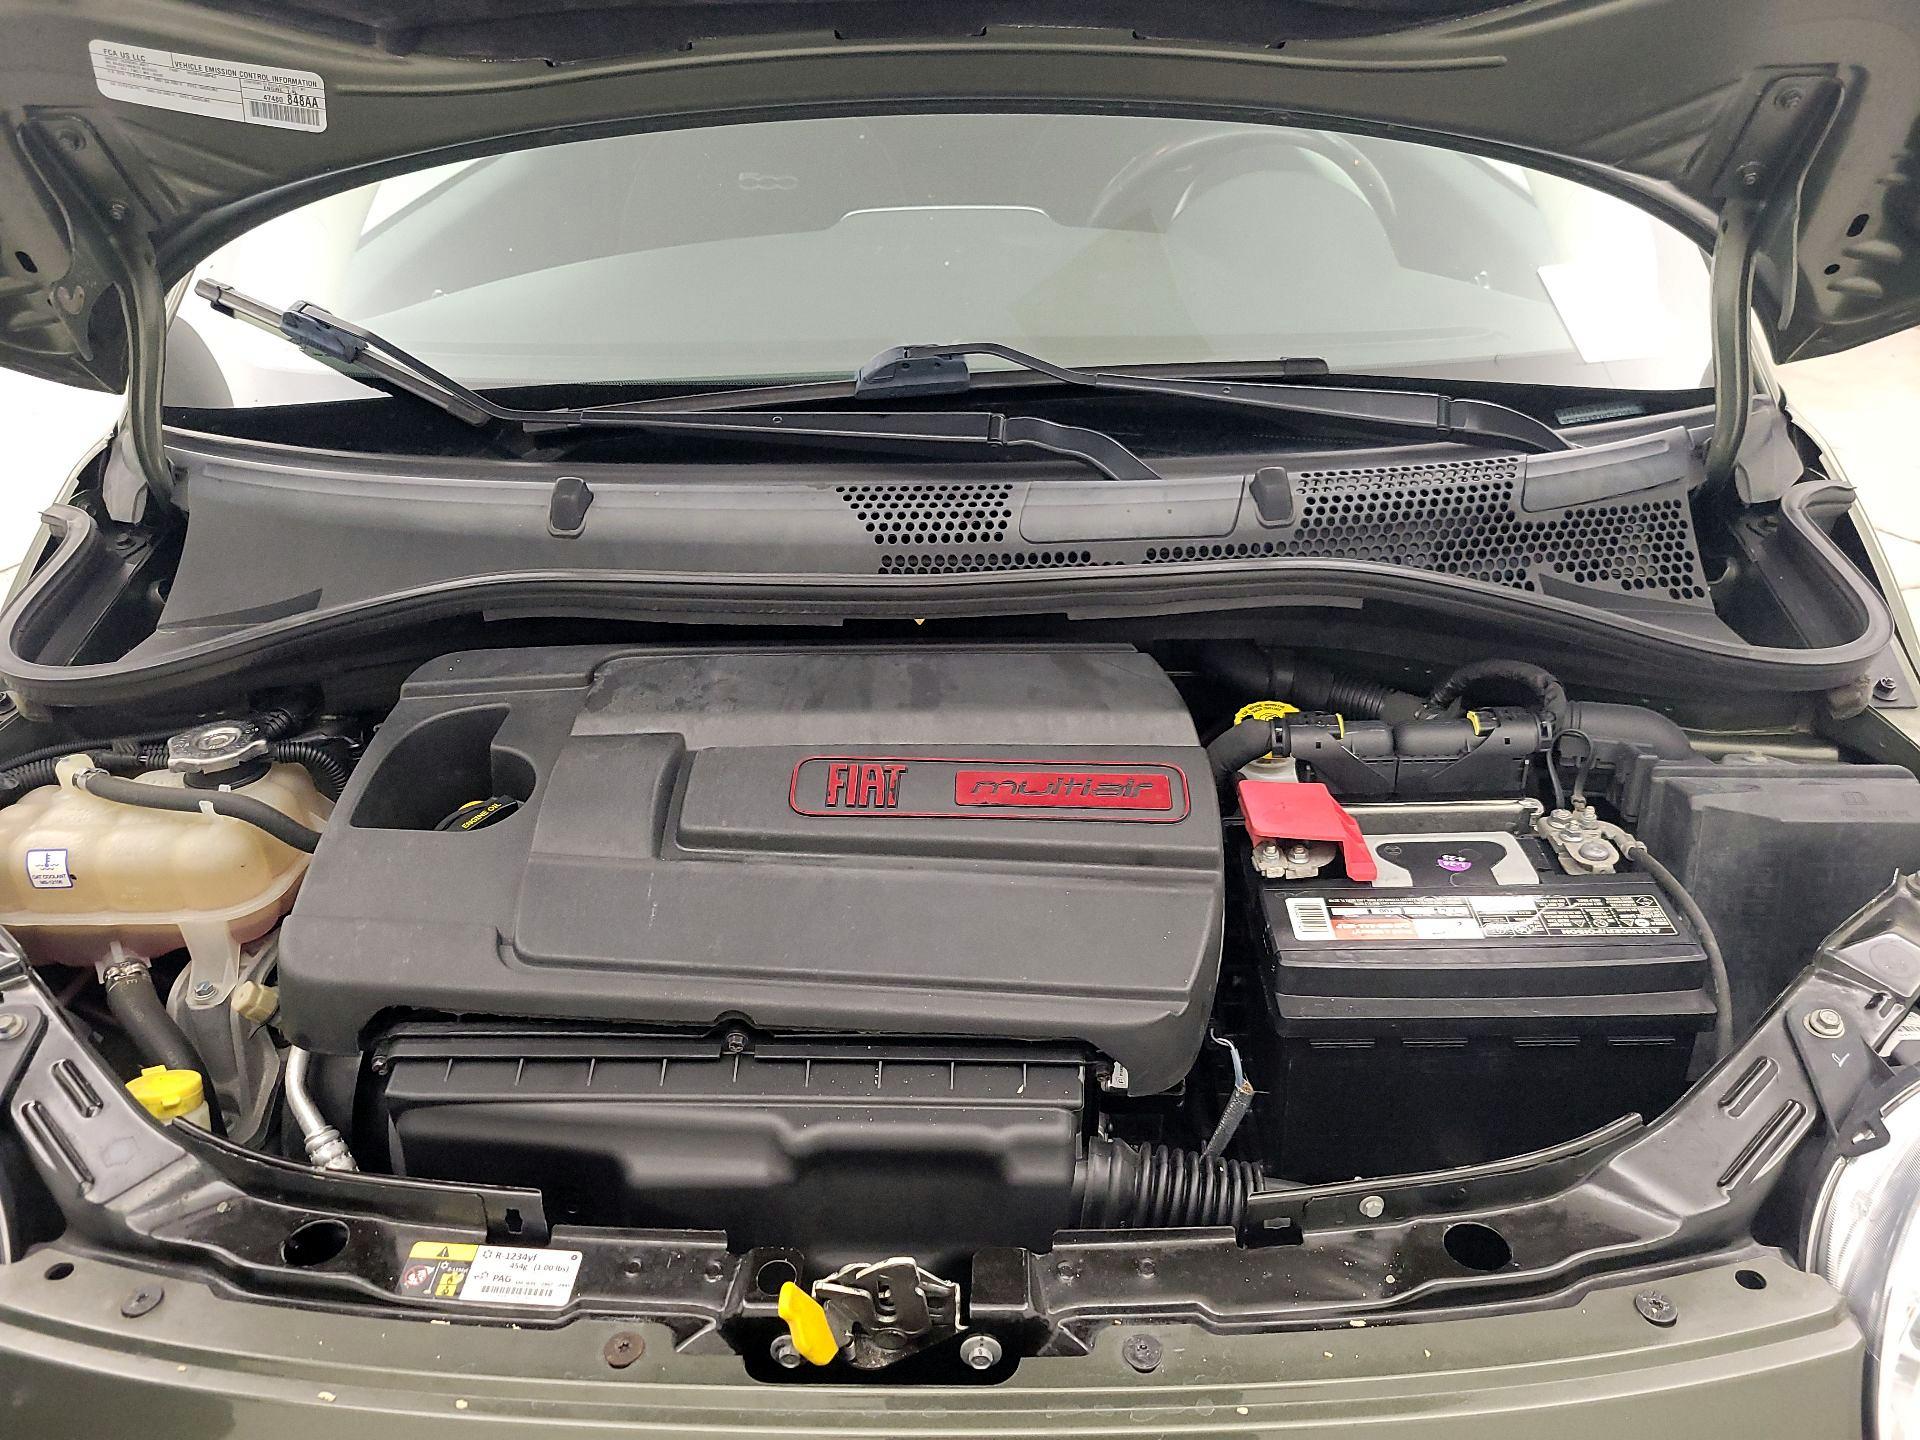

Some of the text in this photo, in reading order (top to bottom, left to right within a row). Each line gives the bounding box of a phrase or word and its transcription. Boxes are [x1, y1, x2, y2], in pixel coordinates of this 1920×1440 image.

[174, 61, 202, 71] VEHICLE
[205, 65, 237, 77] EMISSION
[239, 70, 270, 81] CONTROL
[271, 75, 317, 88] INFORMATION
[287, 94, 319, 108] 848AA
[738, 171, 800, 190] 500
[826, 763, 1153, 808] FIAT multiair
[461, 810, 490, 829] ENGINE
[495, 1251, 538, 1263] R-1234yf
[492, 1274, 512, 1283] PAG
